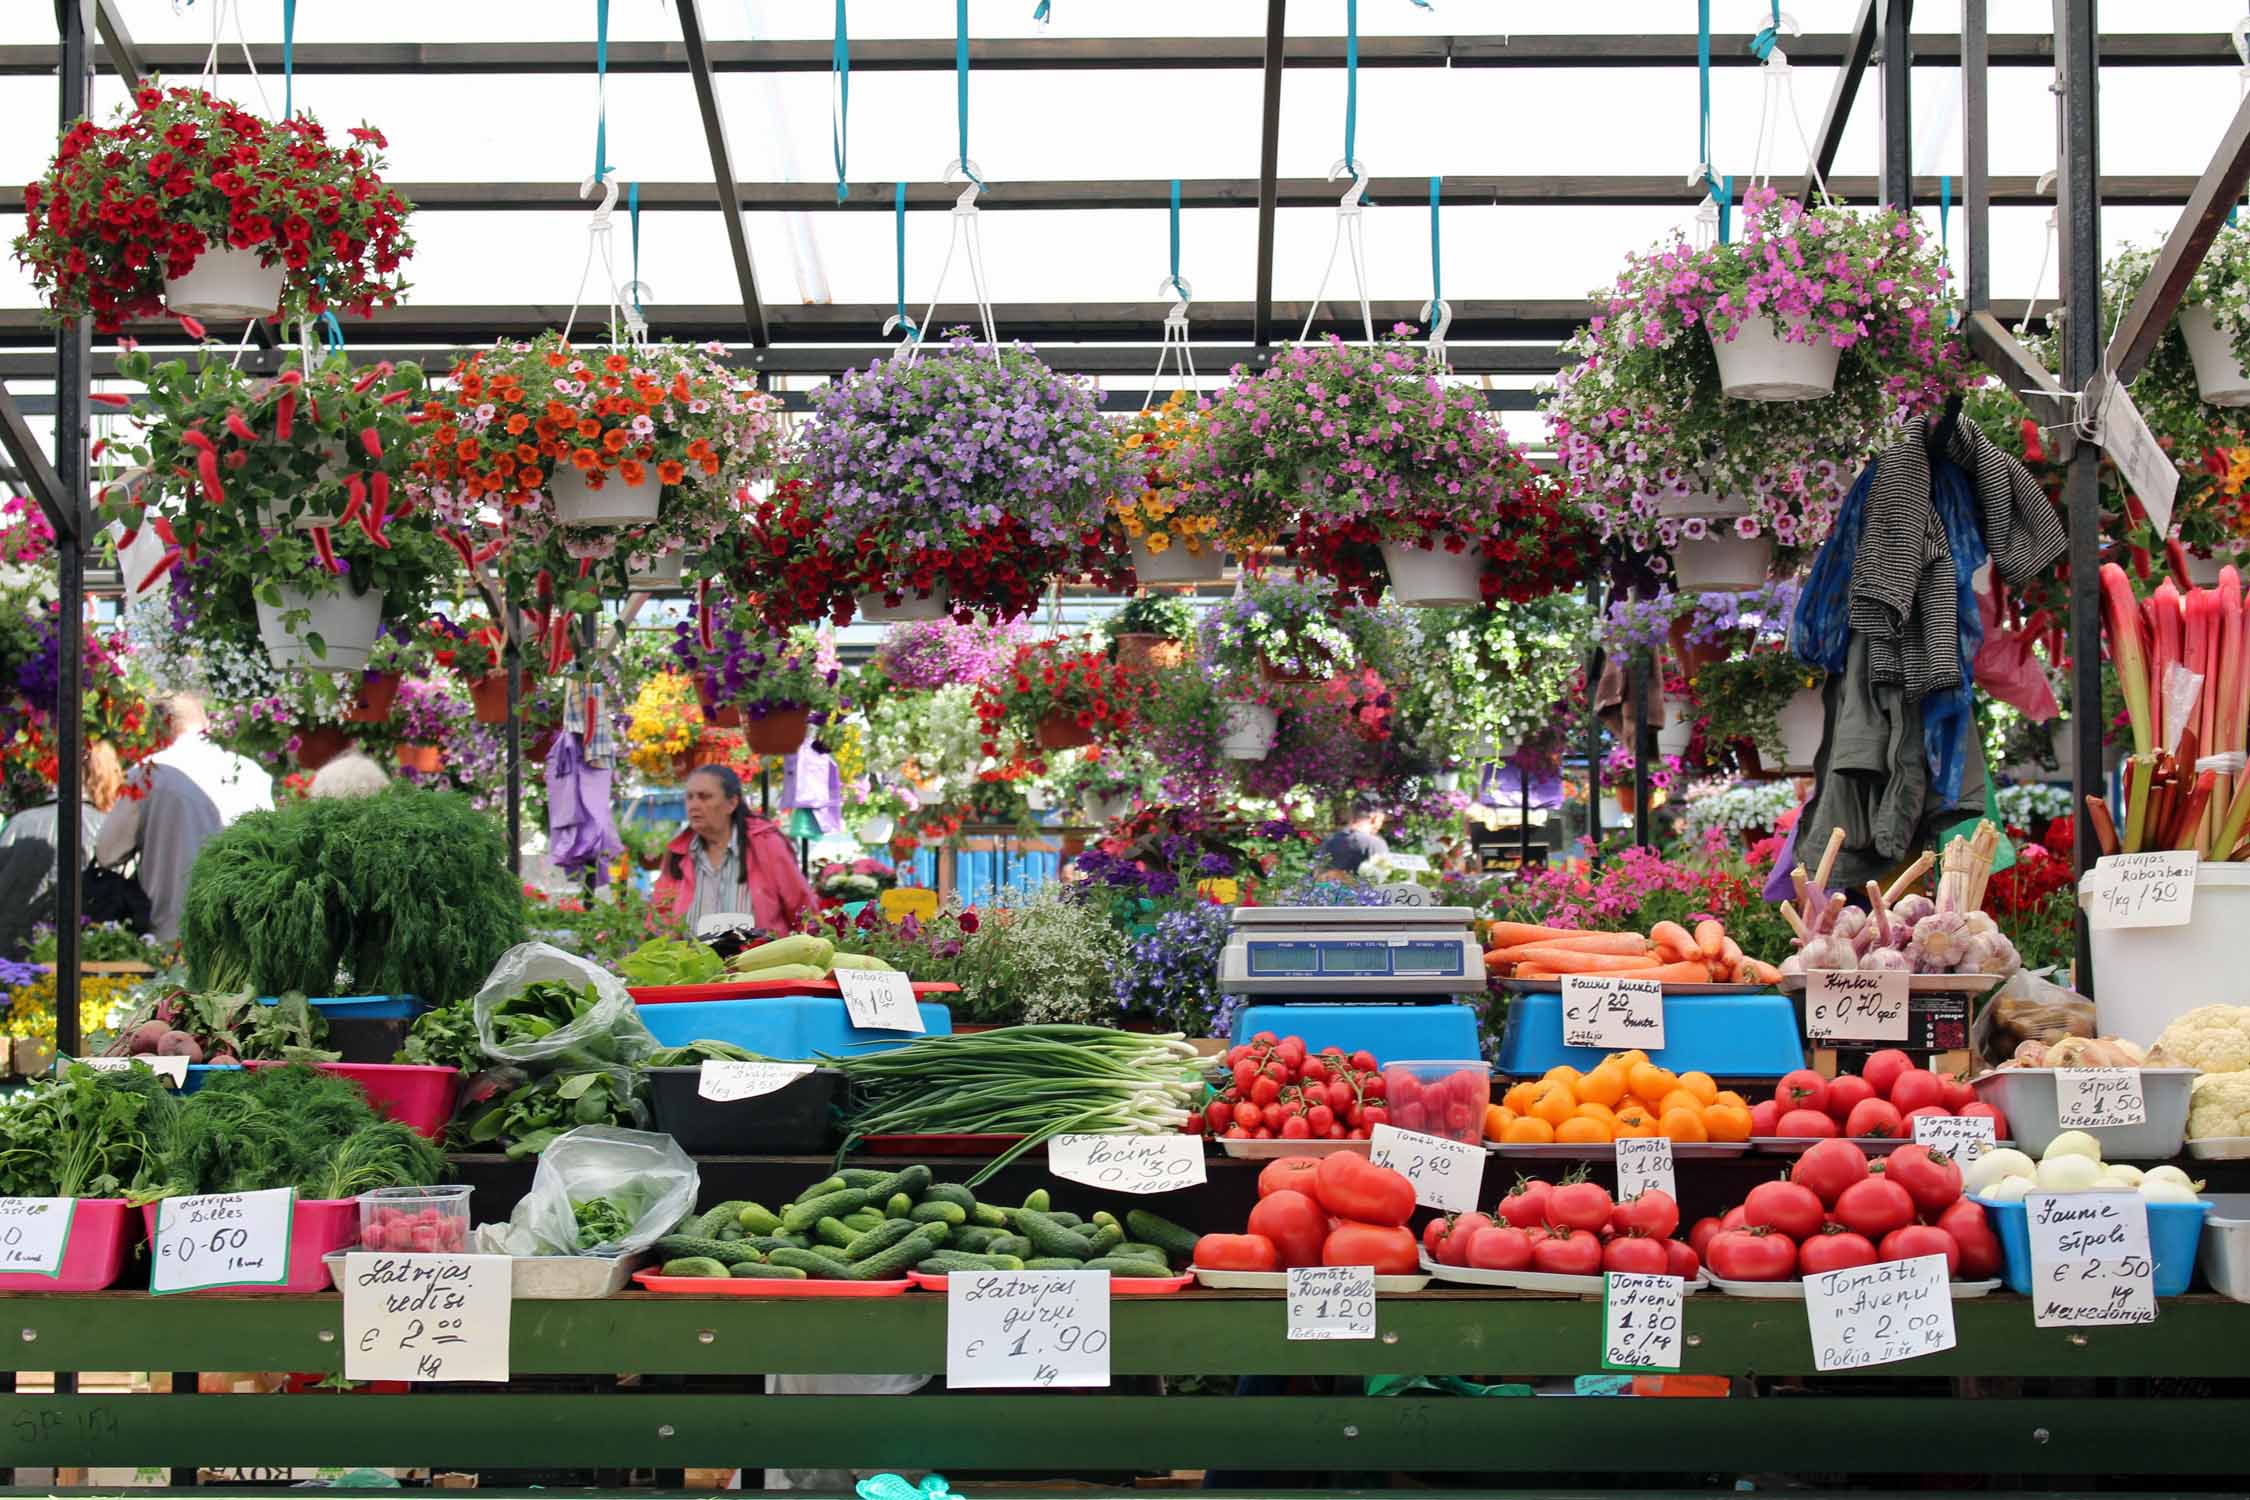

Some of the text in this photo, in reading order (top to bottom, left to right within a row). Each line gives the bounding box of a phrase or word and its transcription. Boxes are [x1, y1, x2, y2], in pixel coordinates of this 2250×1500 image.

[1567, 1007, 1580, 1020] €
[1815, 1005, 1827, 1019] €
[1919, 1116, 1980, 1127] Tomāti
[1636, 1155, 1673, 1174] 1.80
[161, 1243, 172, 1257] €
[2058, 1223, 2126, 1257] sīpoli
[358, 1258, 472, 1288] Latvijas
[1292, 1267, 1356, 1282] Tomāti
[1821, 1260, 1920, 1297] Tomāti
[2052, 1255, 2151, 1282] € 2.50
[965, 1275, 1077, 1307] Latvijas
[1610, 1273, 1673, 1289] Tomāti
[1294, 1298, 1373, 1319] € 1.20
[1618, 1310, 1677, 1331] 1.80
[1842, 1313, 1940, 1345] € 2.00
[359, 1328, 380, 1352] €
[965, 1325, 1108, 1358] € 1.90
